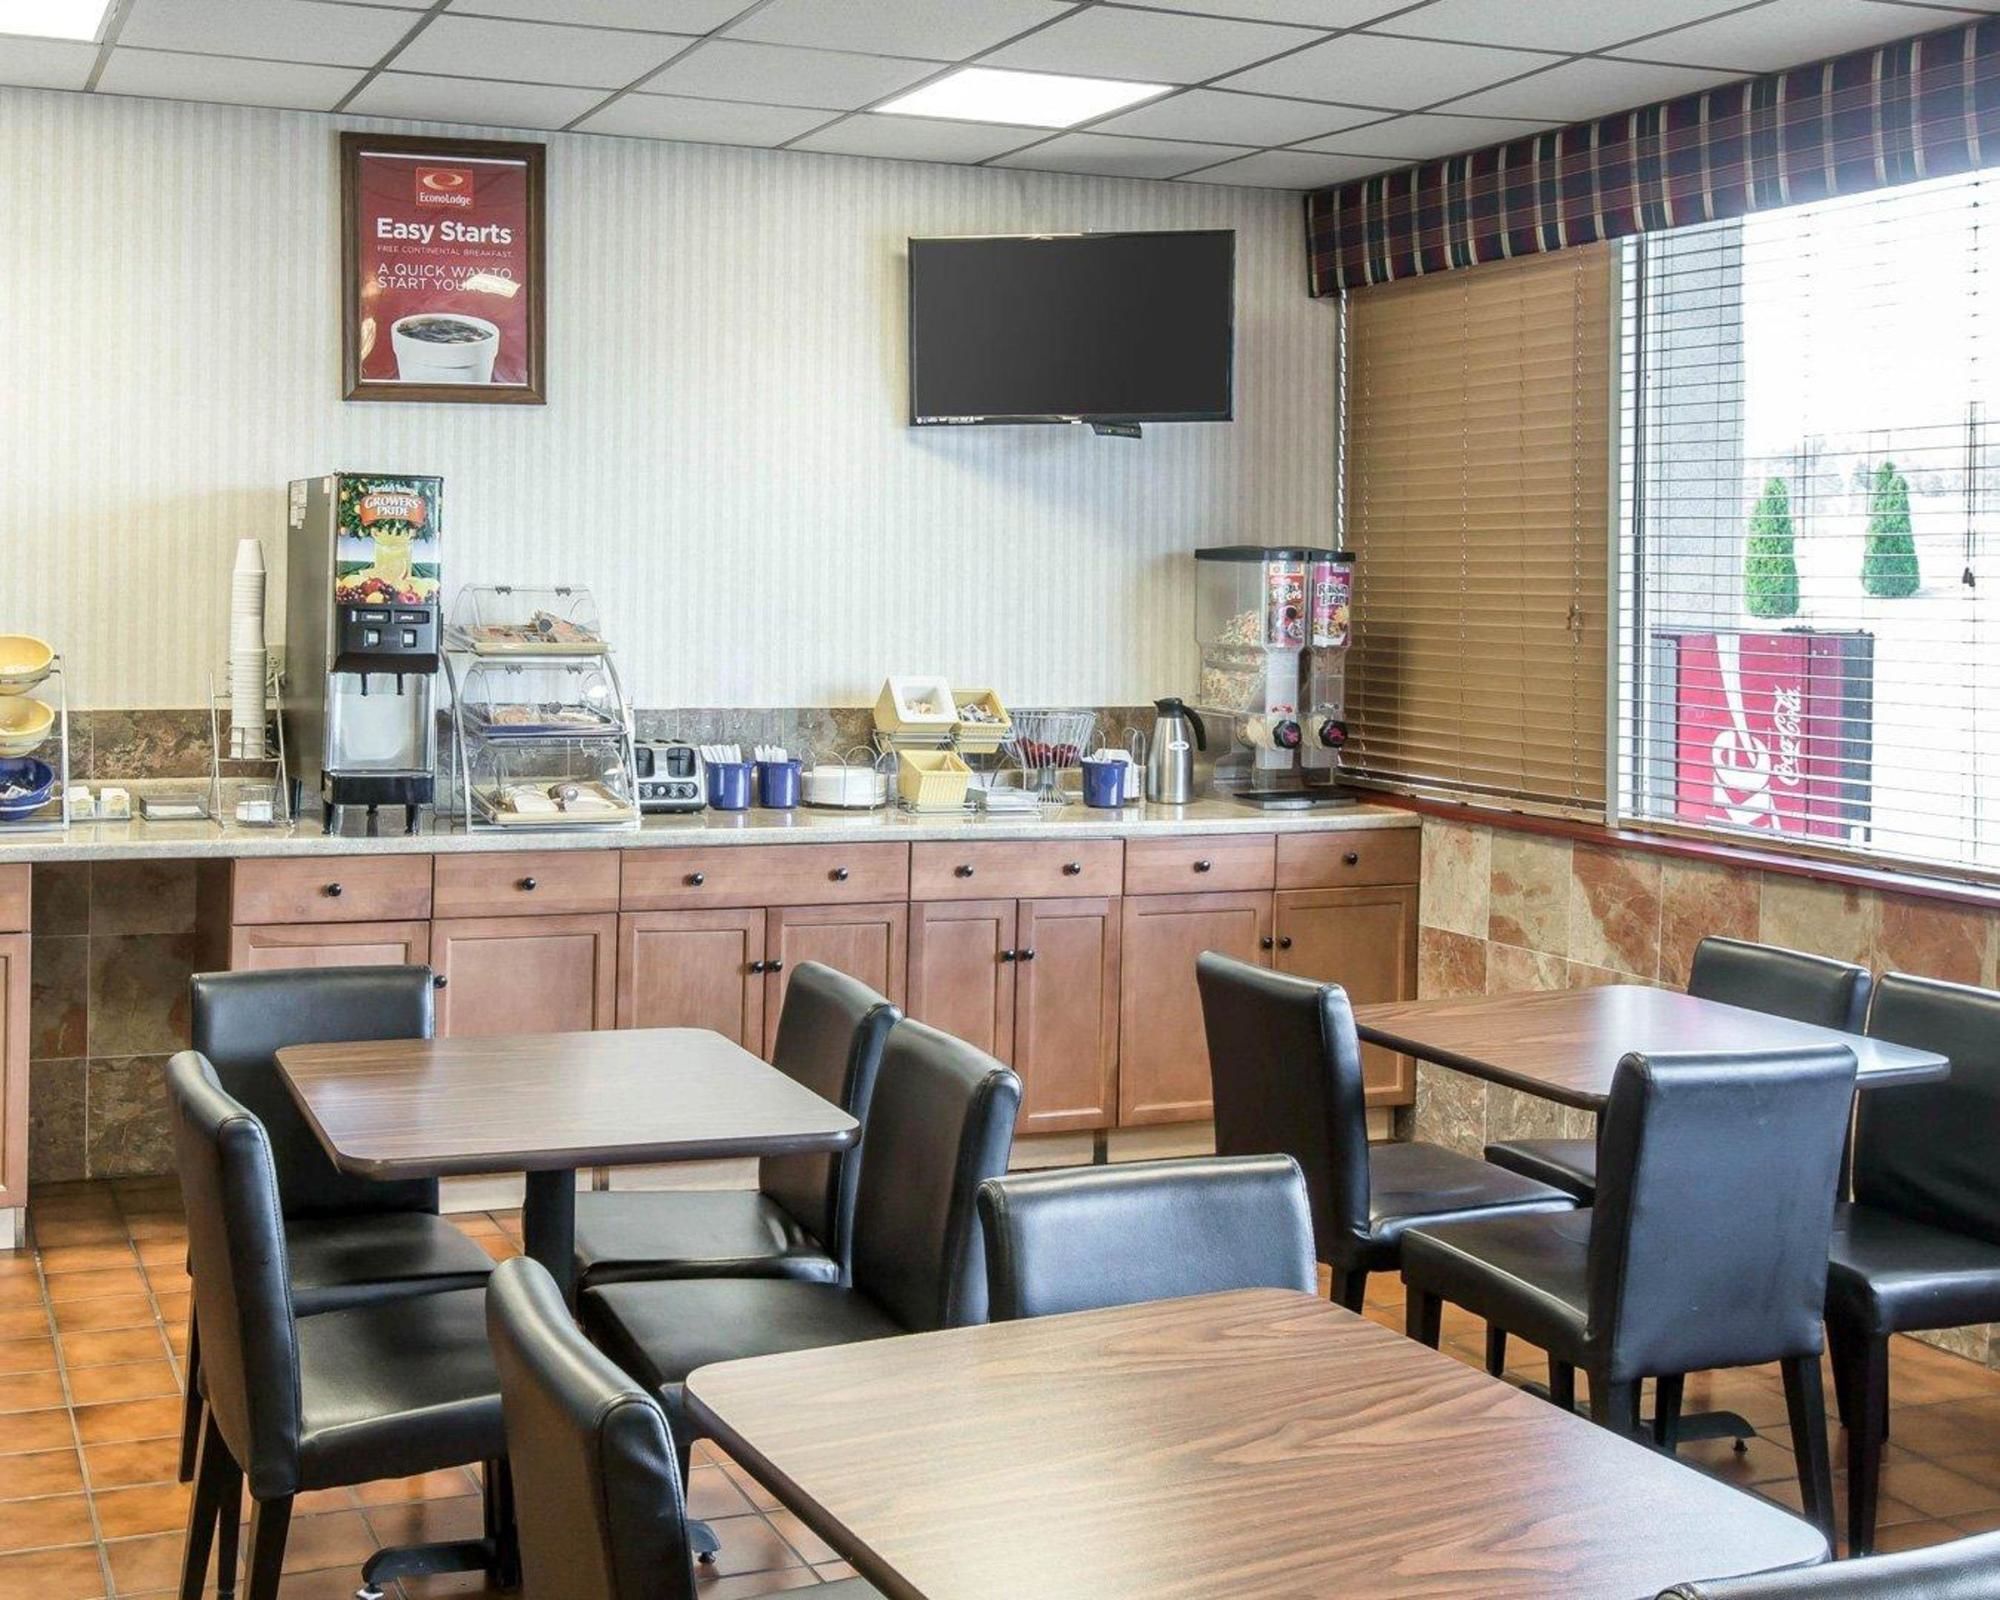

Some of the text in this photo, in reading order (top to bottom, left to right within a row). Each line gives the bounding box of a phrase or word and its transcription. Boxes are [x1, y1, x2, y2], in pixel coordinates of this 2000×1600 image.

[419, 192, 472, 207] EconoLodge
[377, 217, 512, 244] Easy Starts
[377, 245, 399, 253] FREE
[401, 246, 461, 256] CONTINENTAL
[377, 263, 389, 275] A
[394, 263, 445, 278] QUICK
[491, 268, 512, 280] TO
[378, 277, 427, 289] START
[376, 506, 411, 517] PRIDE
